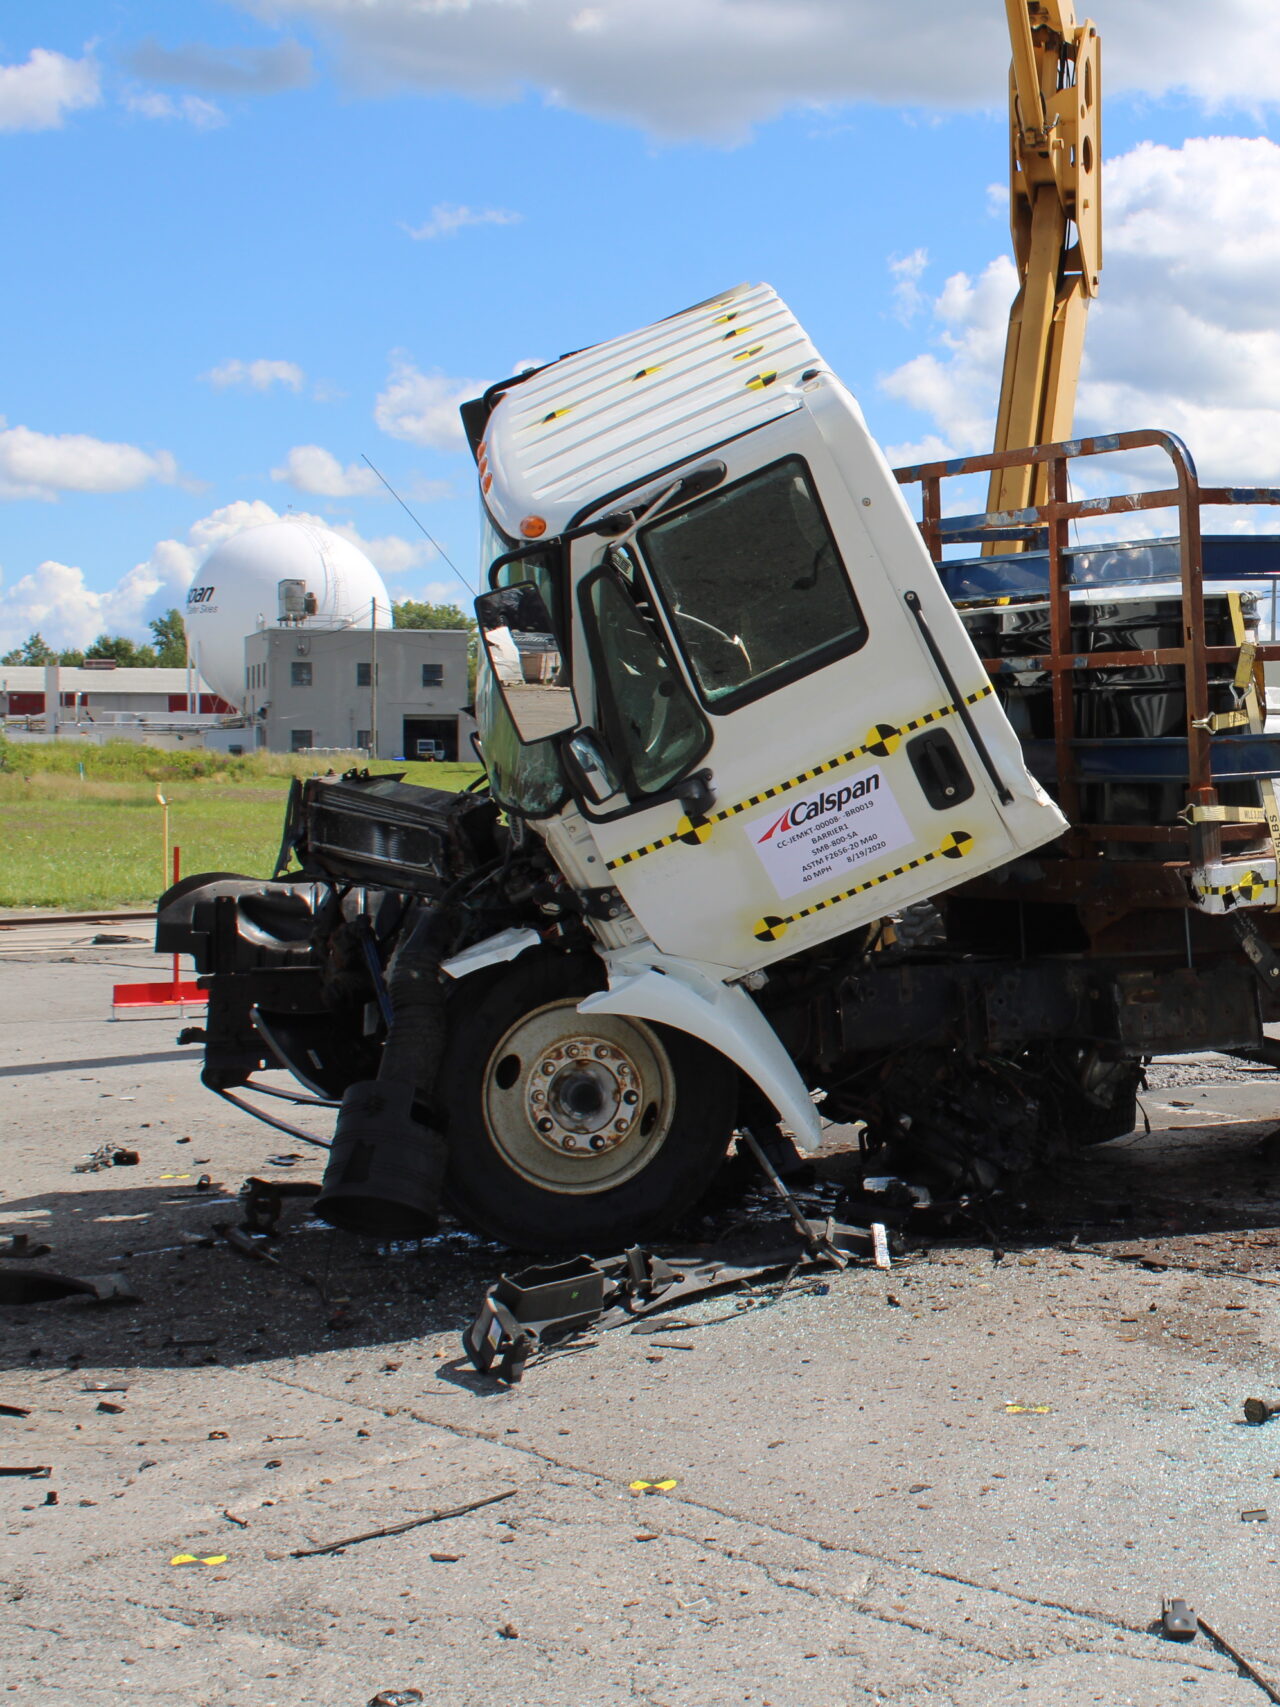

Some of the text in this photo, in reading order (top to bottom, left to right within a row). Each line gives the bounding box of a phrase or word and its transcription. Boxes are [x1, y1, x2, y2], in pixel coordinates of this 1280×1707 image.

[790, 773, 880, 826] Calspan
[802, 833, 878, 872] ASTM F2656-20 M40
[811, 823, 849, 845] BARRIER1
[802, 841, 887, 883] 40 MPH 8/19/2020
